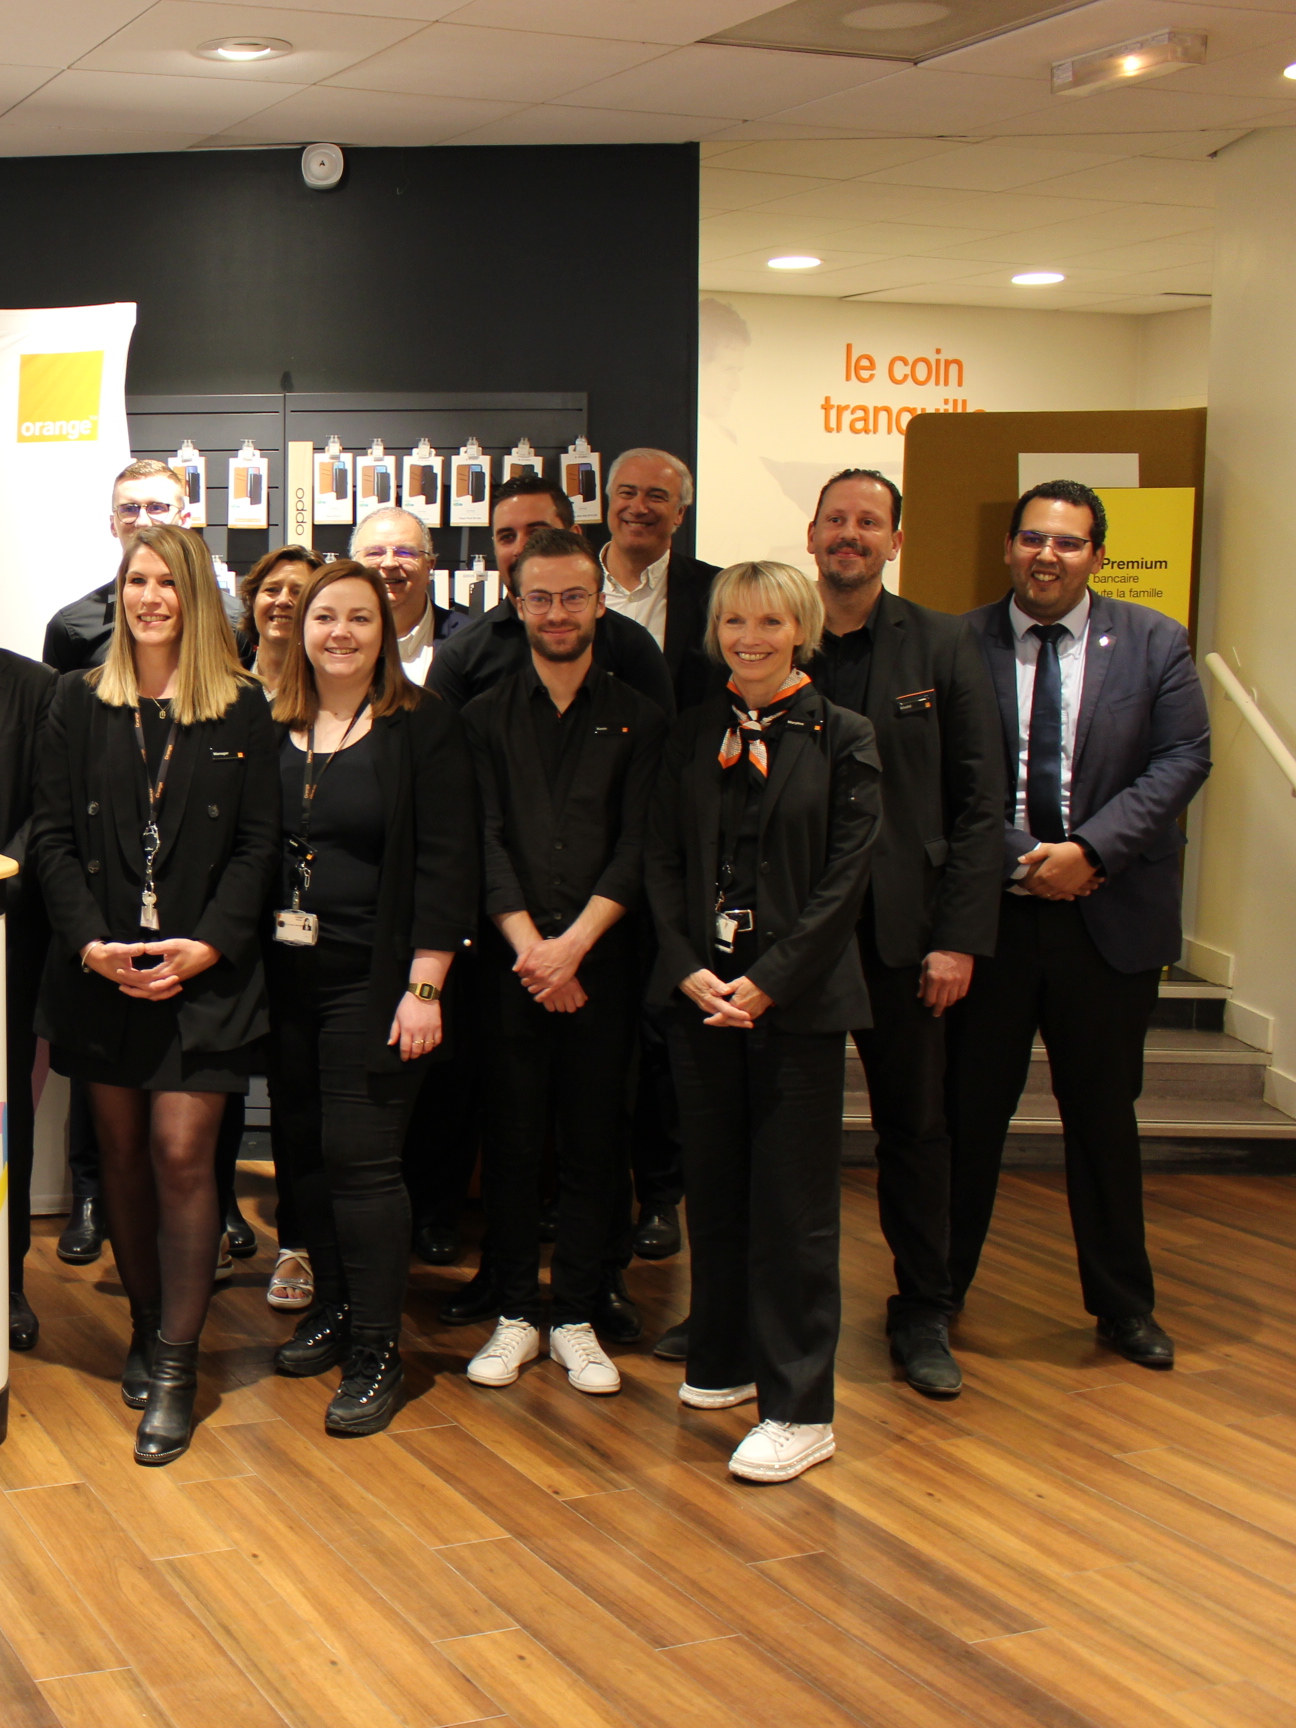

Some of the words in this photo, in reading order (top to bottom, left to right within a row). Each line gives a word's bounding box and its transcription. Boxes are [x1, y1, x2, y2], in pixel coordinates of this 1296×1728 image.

[845, 343, 877, 383] le
[888, 348, 964, 387] coin
[21, 420, 92, 439] orange
[295, 487, 308, 536] oppo
[1101, 557, 1168, 570] Premium
[1093, 573, 1140, 584] bancaire
[1116, 588, 1126, 598] la
[1129, 588, 1164, 598] famille
